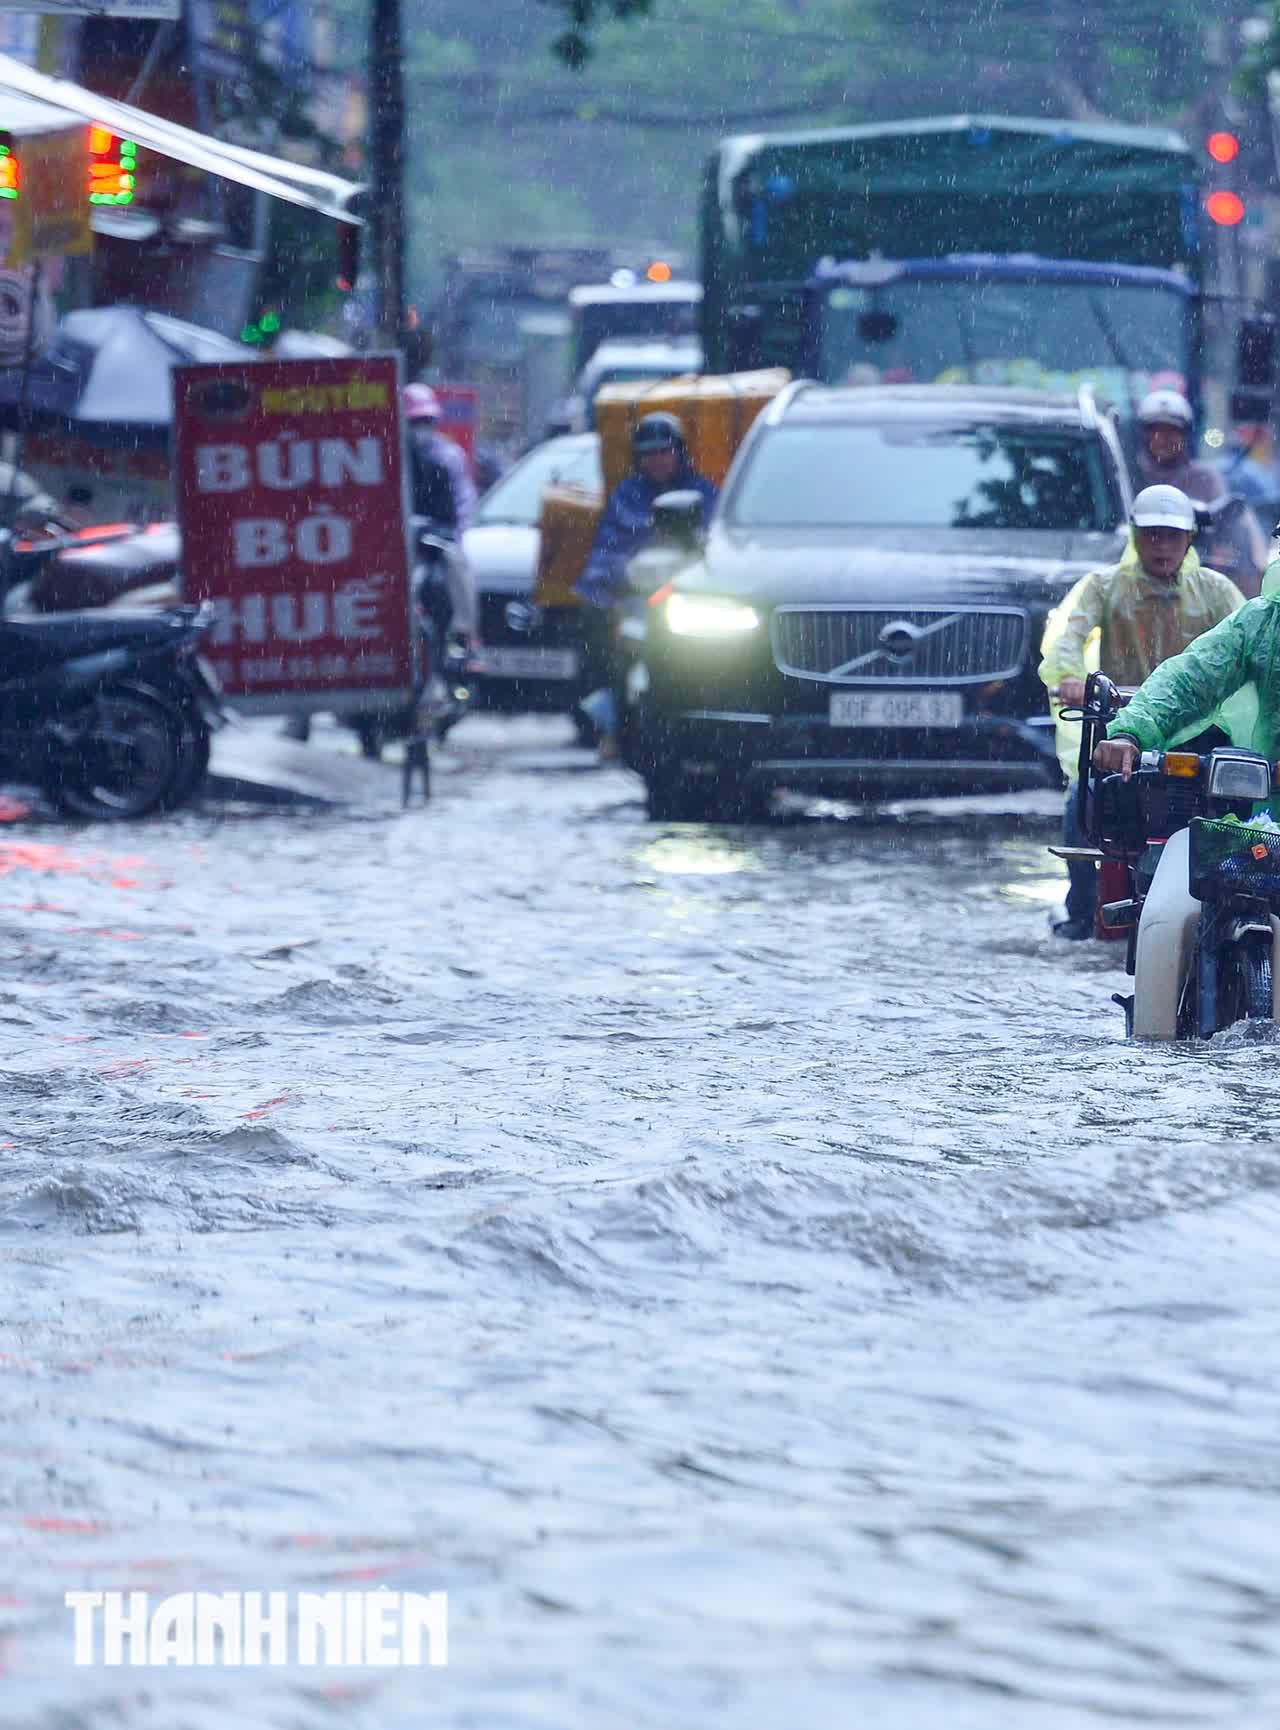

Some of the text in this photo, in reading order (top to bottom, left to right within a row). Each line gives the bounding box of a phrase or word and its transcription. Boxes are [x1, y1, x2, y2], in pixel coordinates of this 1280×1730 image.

[195, 430, 384, 493] BÚN
[233, 503, 352, 568] BÒ
[209, 572, 385, 644] HUẾ
